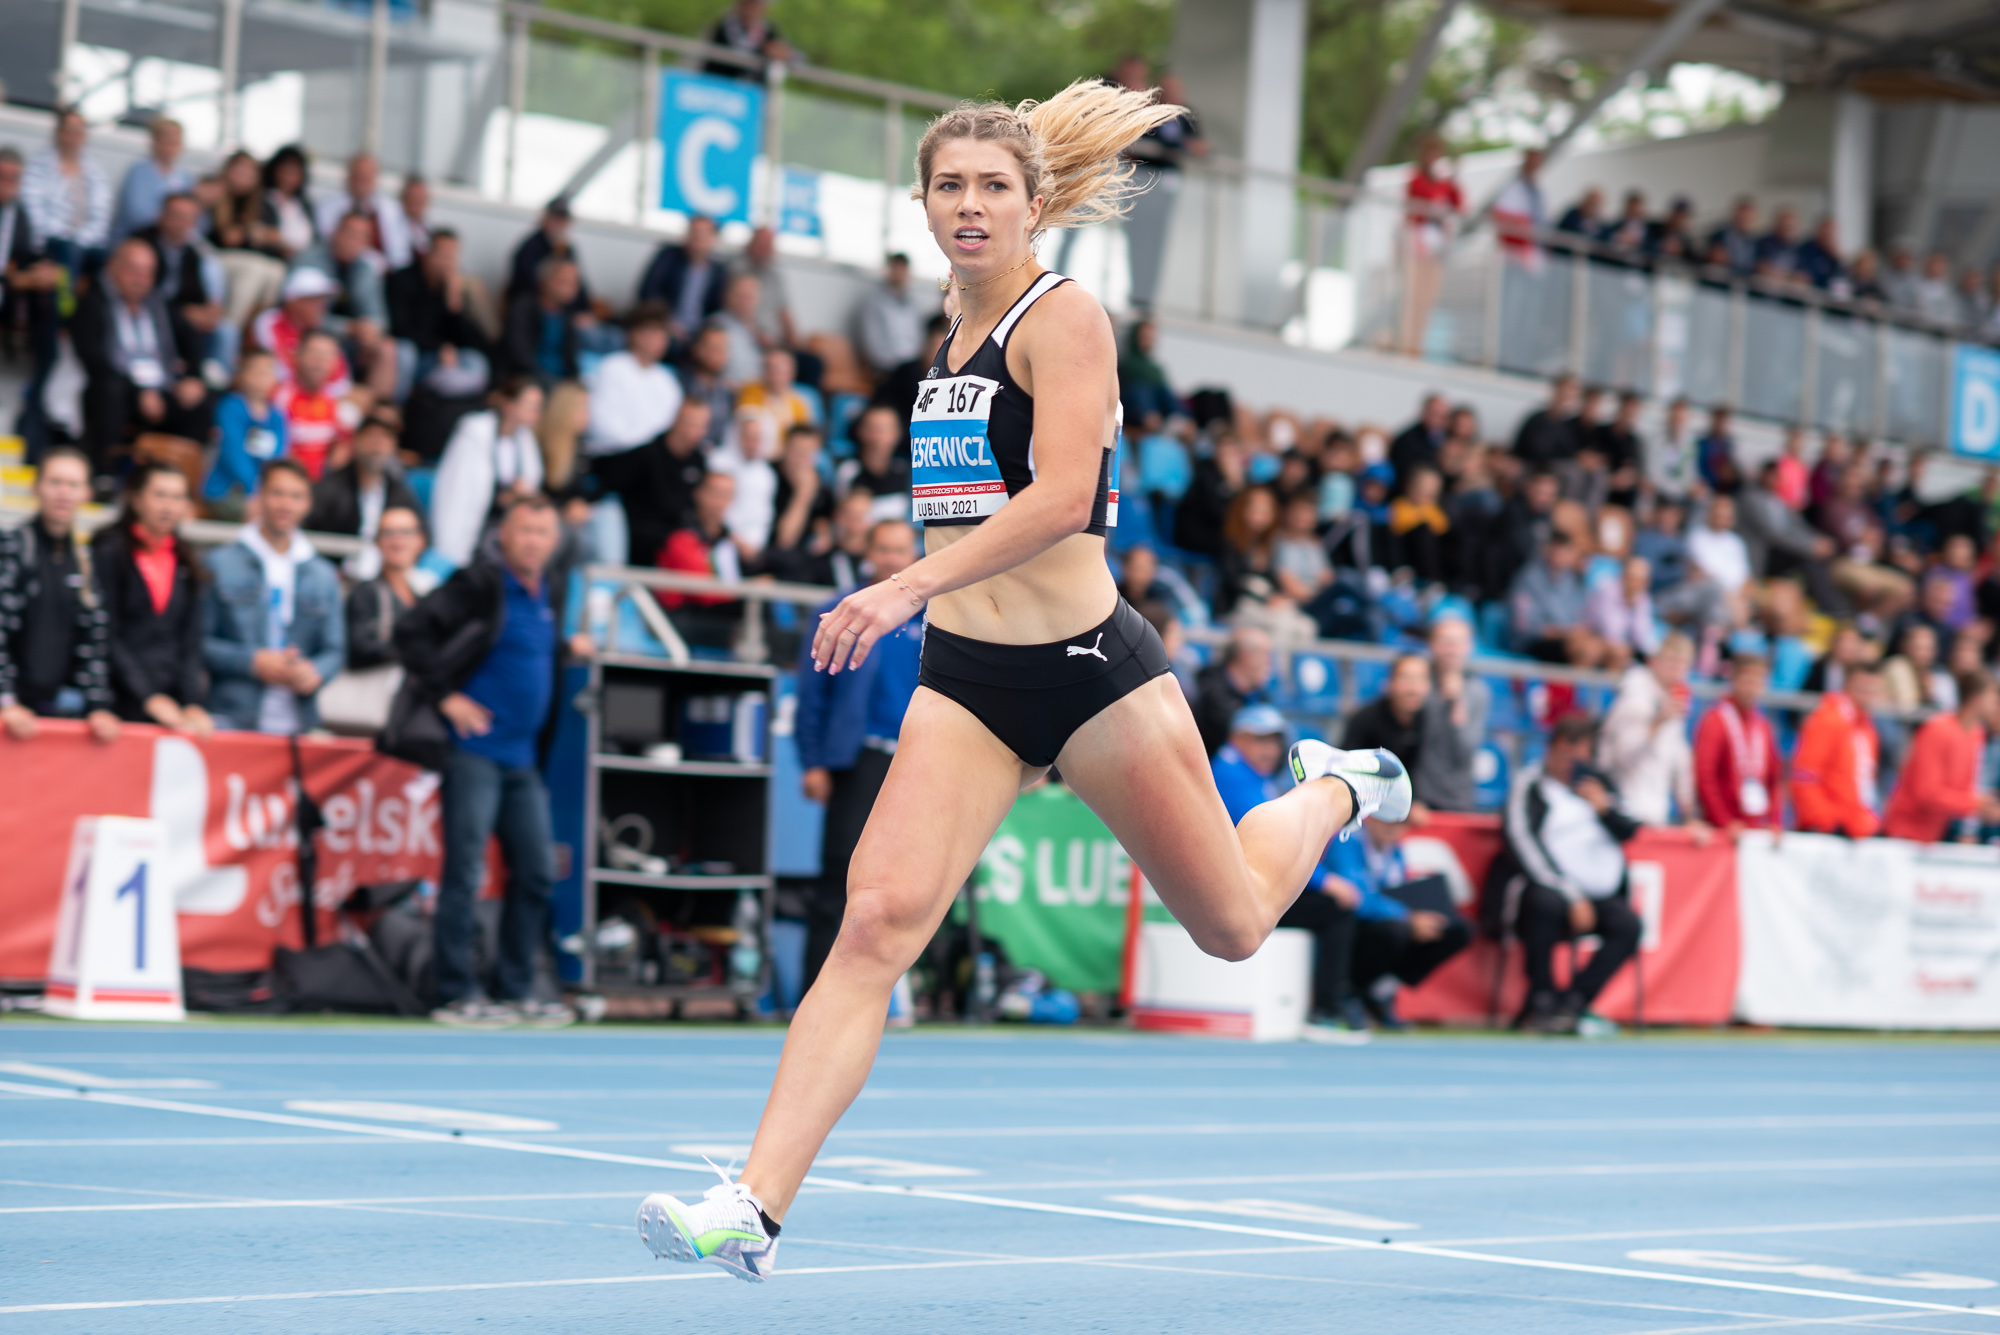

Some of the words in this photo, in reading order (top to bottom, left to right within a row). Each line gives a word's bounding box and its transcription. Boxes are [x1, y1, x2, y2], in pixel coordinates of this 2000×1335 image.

[677, 115, 740, 216] C
[947, 381, 987, 413] 167
[1961, 378, 1999, 454] D
[917, 502, 949, 517] LUBLIN
[952, 500, 978, 514] 2021
[964, 485, 985, 493] POLSKI
[986, 484, 1001, 492] U20
[112, 861, 149, 972] 1
